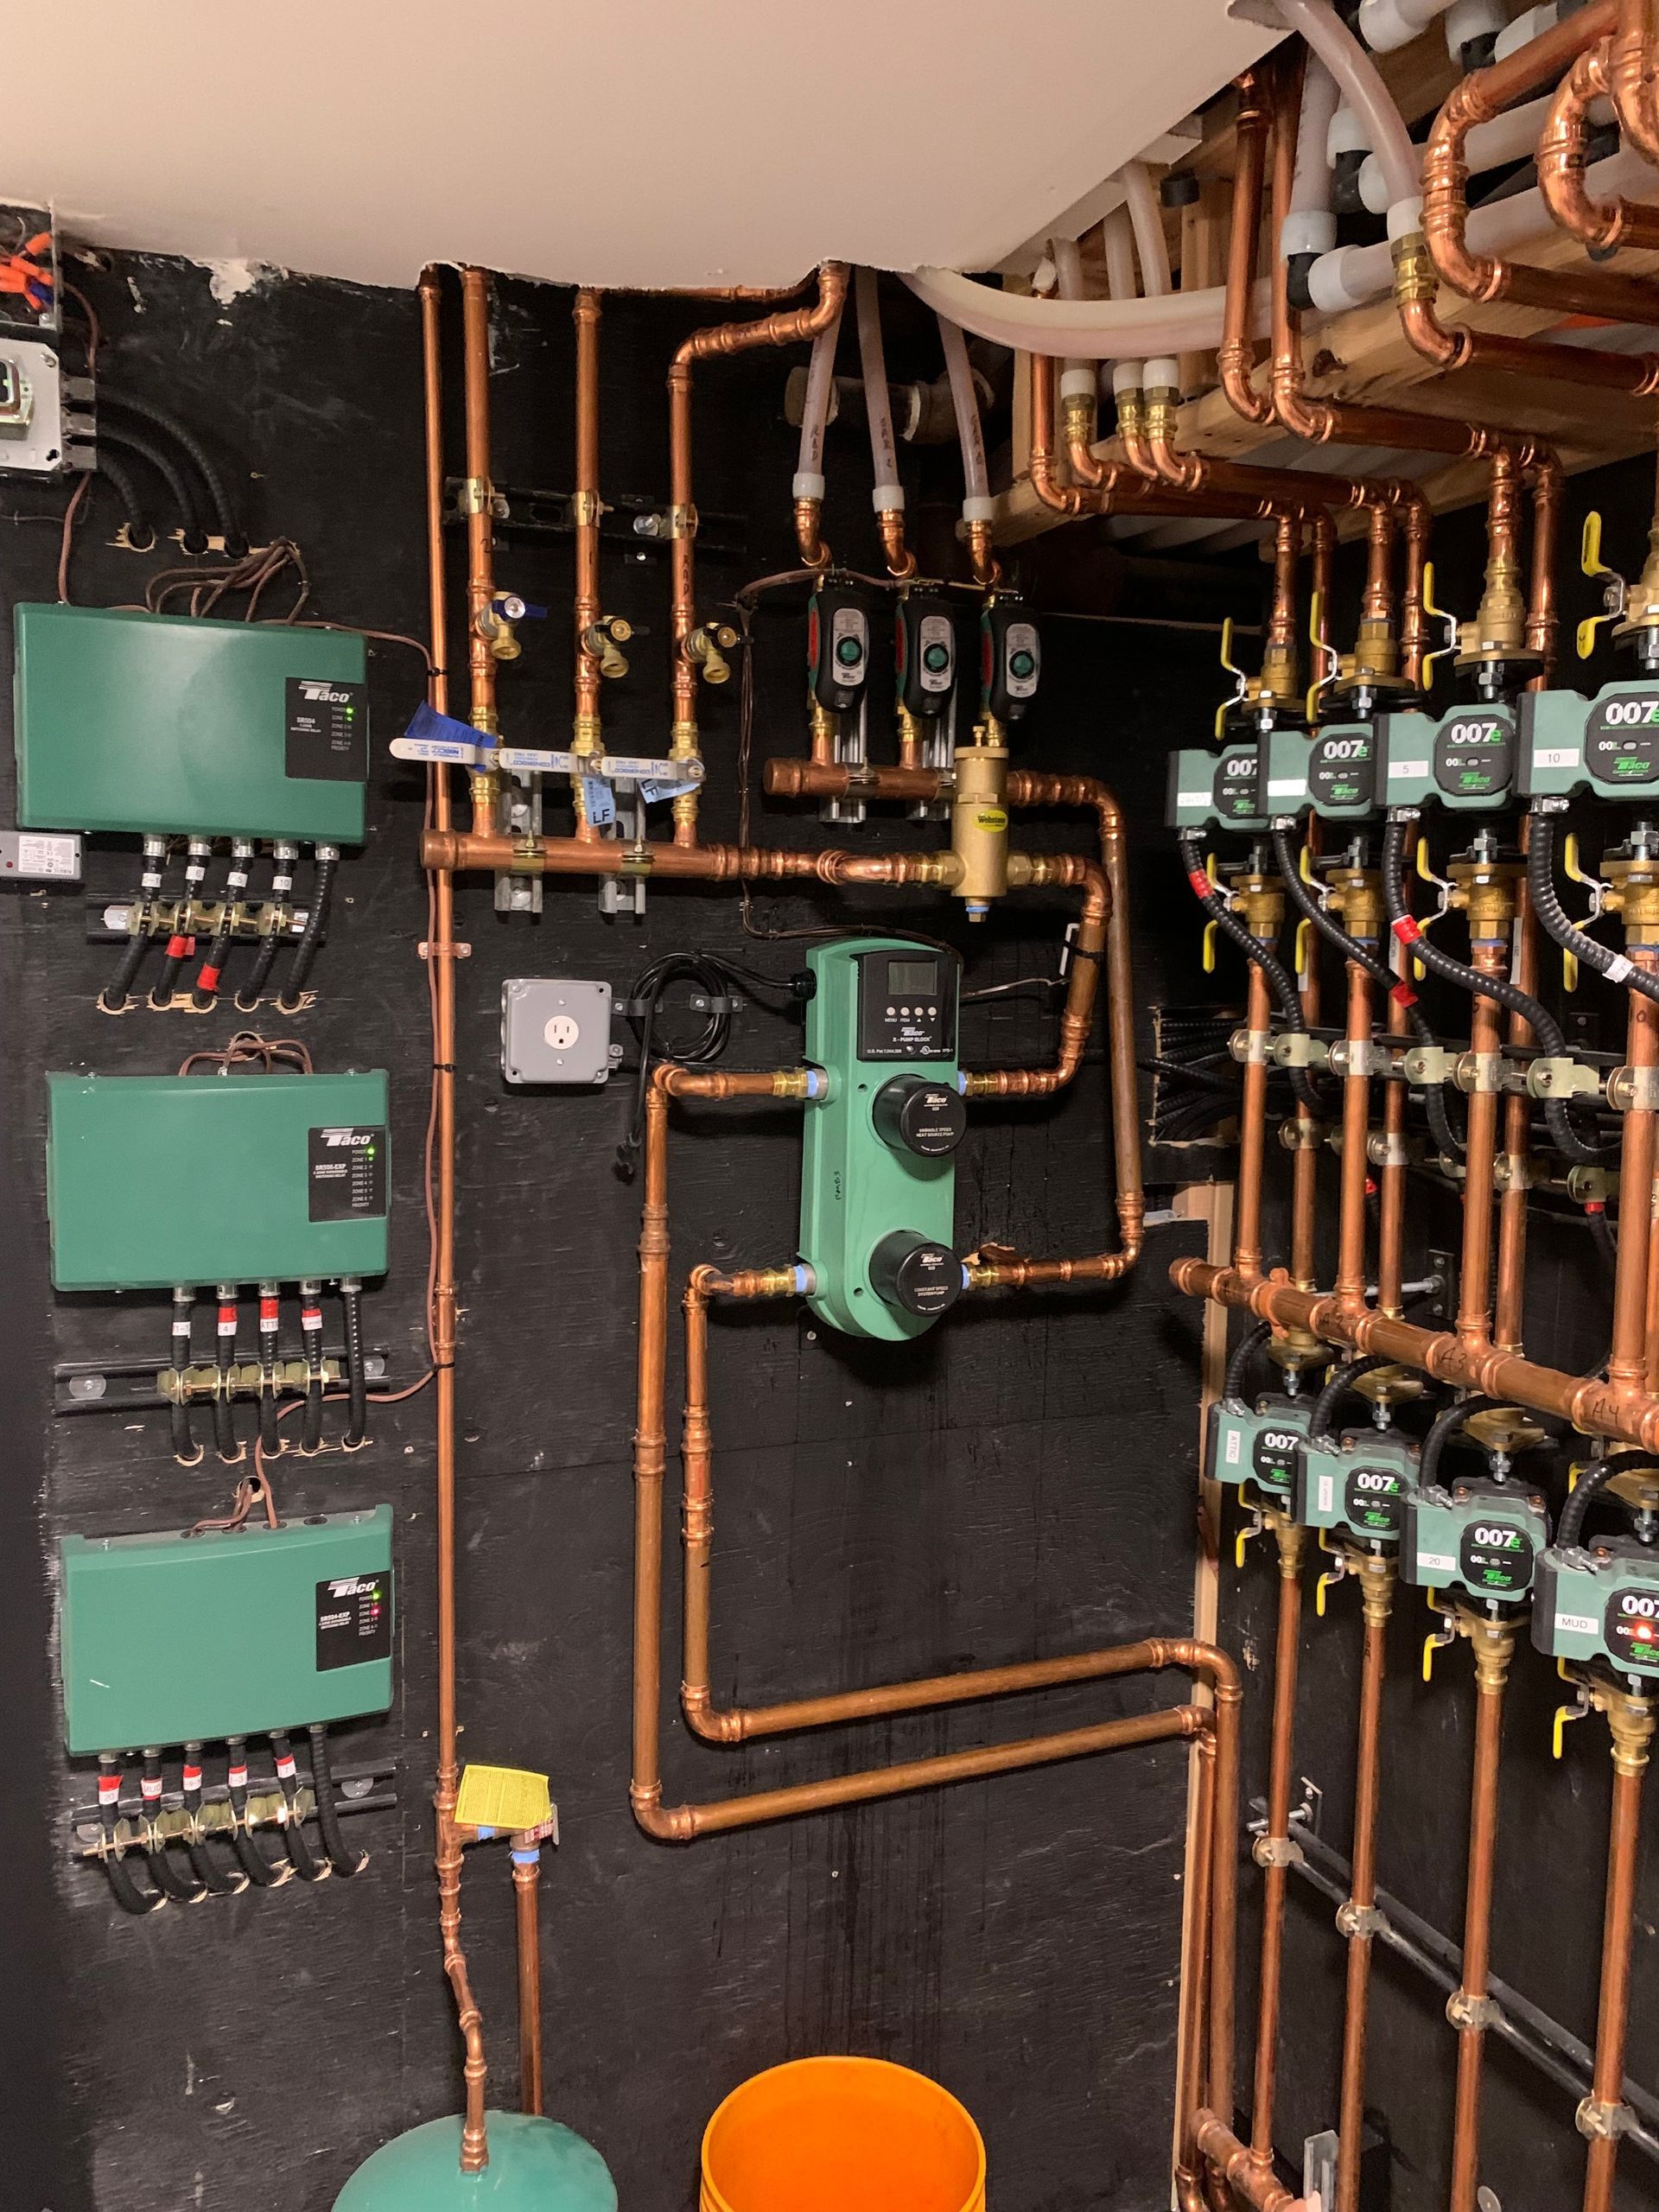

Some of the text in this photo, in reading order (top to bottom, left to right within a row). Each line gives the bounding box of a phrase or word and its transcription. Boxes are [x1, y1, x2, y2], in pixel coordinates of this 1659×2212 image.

[298, 680, 350, 703] Taco
[1548, 753, 1560, 764] 10
[1402, 765, 1409, 774] 5
[593, 808, 610, 823] LF
[279, 879, 290, 888] 10
[925, 1093, 947, 1103] Taco
[321, 1128, 371, 1147] Taco
[920, 1253, 942, 1263] Taco
[1592, 1398, 1620, 1427] A4
[1229, 1435, 1237, 1459] ATTIC
[1428, 1557, 1440, 1566] 20
[327, 1577, 376, 1598] Taco
[1561, 1618, 1588, 1630] MUD
